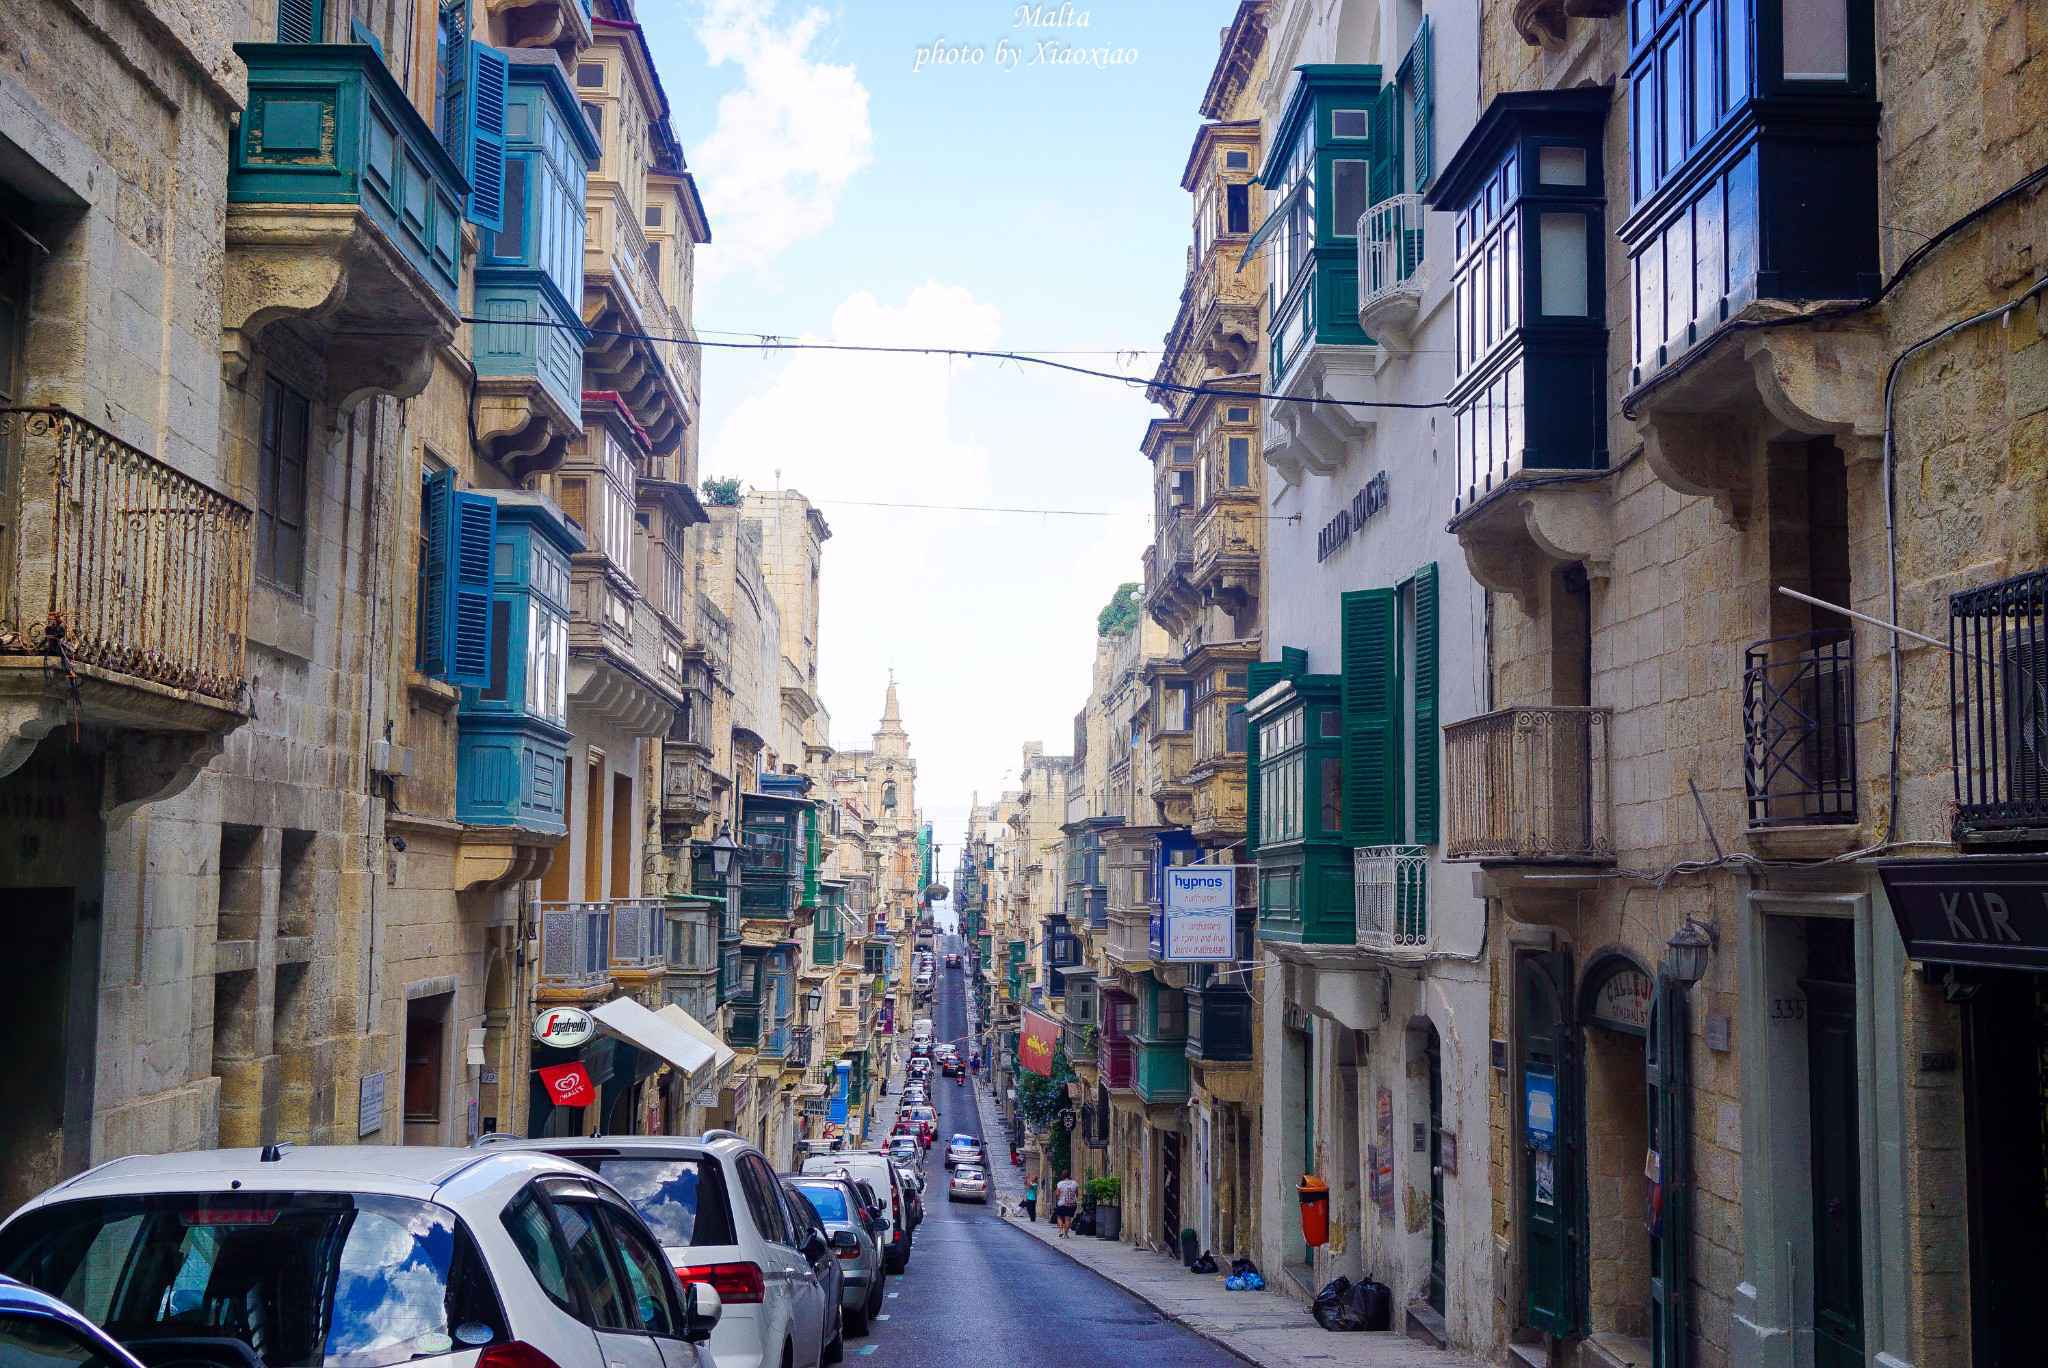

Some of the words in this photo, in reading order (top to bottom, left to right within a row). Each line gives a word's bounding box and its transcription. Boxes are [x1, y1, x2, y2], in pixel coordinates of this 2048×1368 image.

[1175, 874, 1223, 889] hypnos
[1939, 892, 2021, 941] KIR
[542, 1014, 587, 1037] Segafredo
